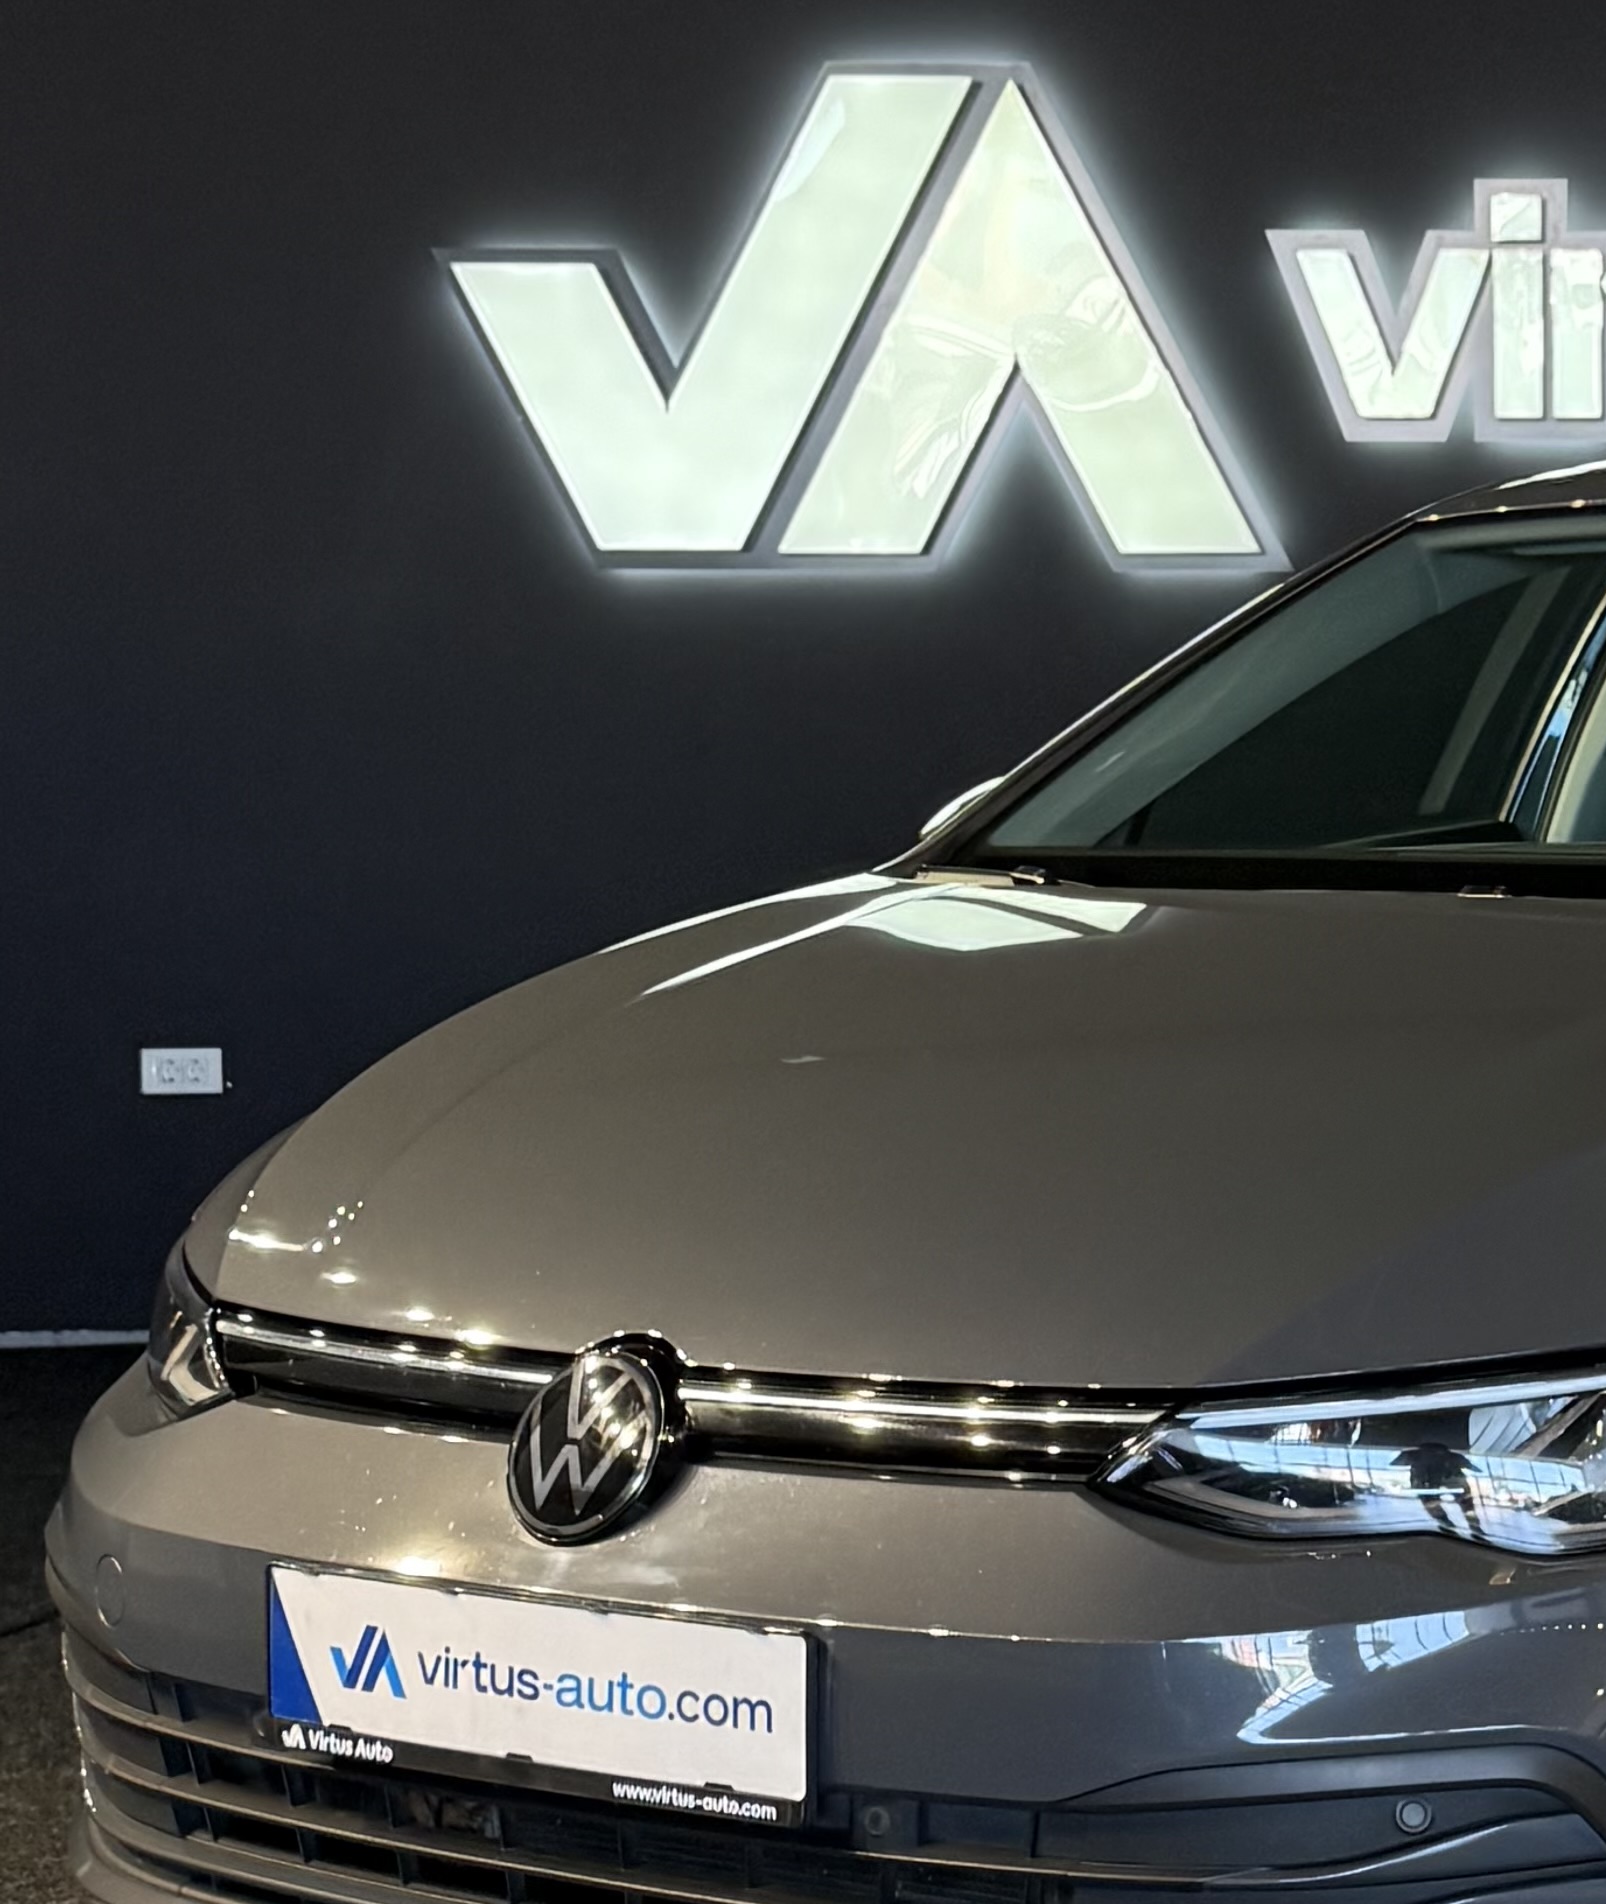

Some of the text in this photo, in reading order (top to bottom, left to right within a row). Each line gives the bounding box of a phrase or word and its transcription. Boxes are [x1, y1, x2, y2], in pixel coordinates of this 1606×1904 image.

[418, 1645, 774, 1734] virtus-auto.com
[308, 1728, 353, 1757] Virtus
[354, 1737, 394, 1764] Auto
[612, 1781, 778, 1821] www.virtus-auto.com
